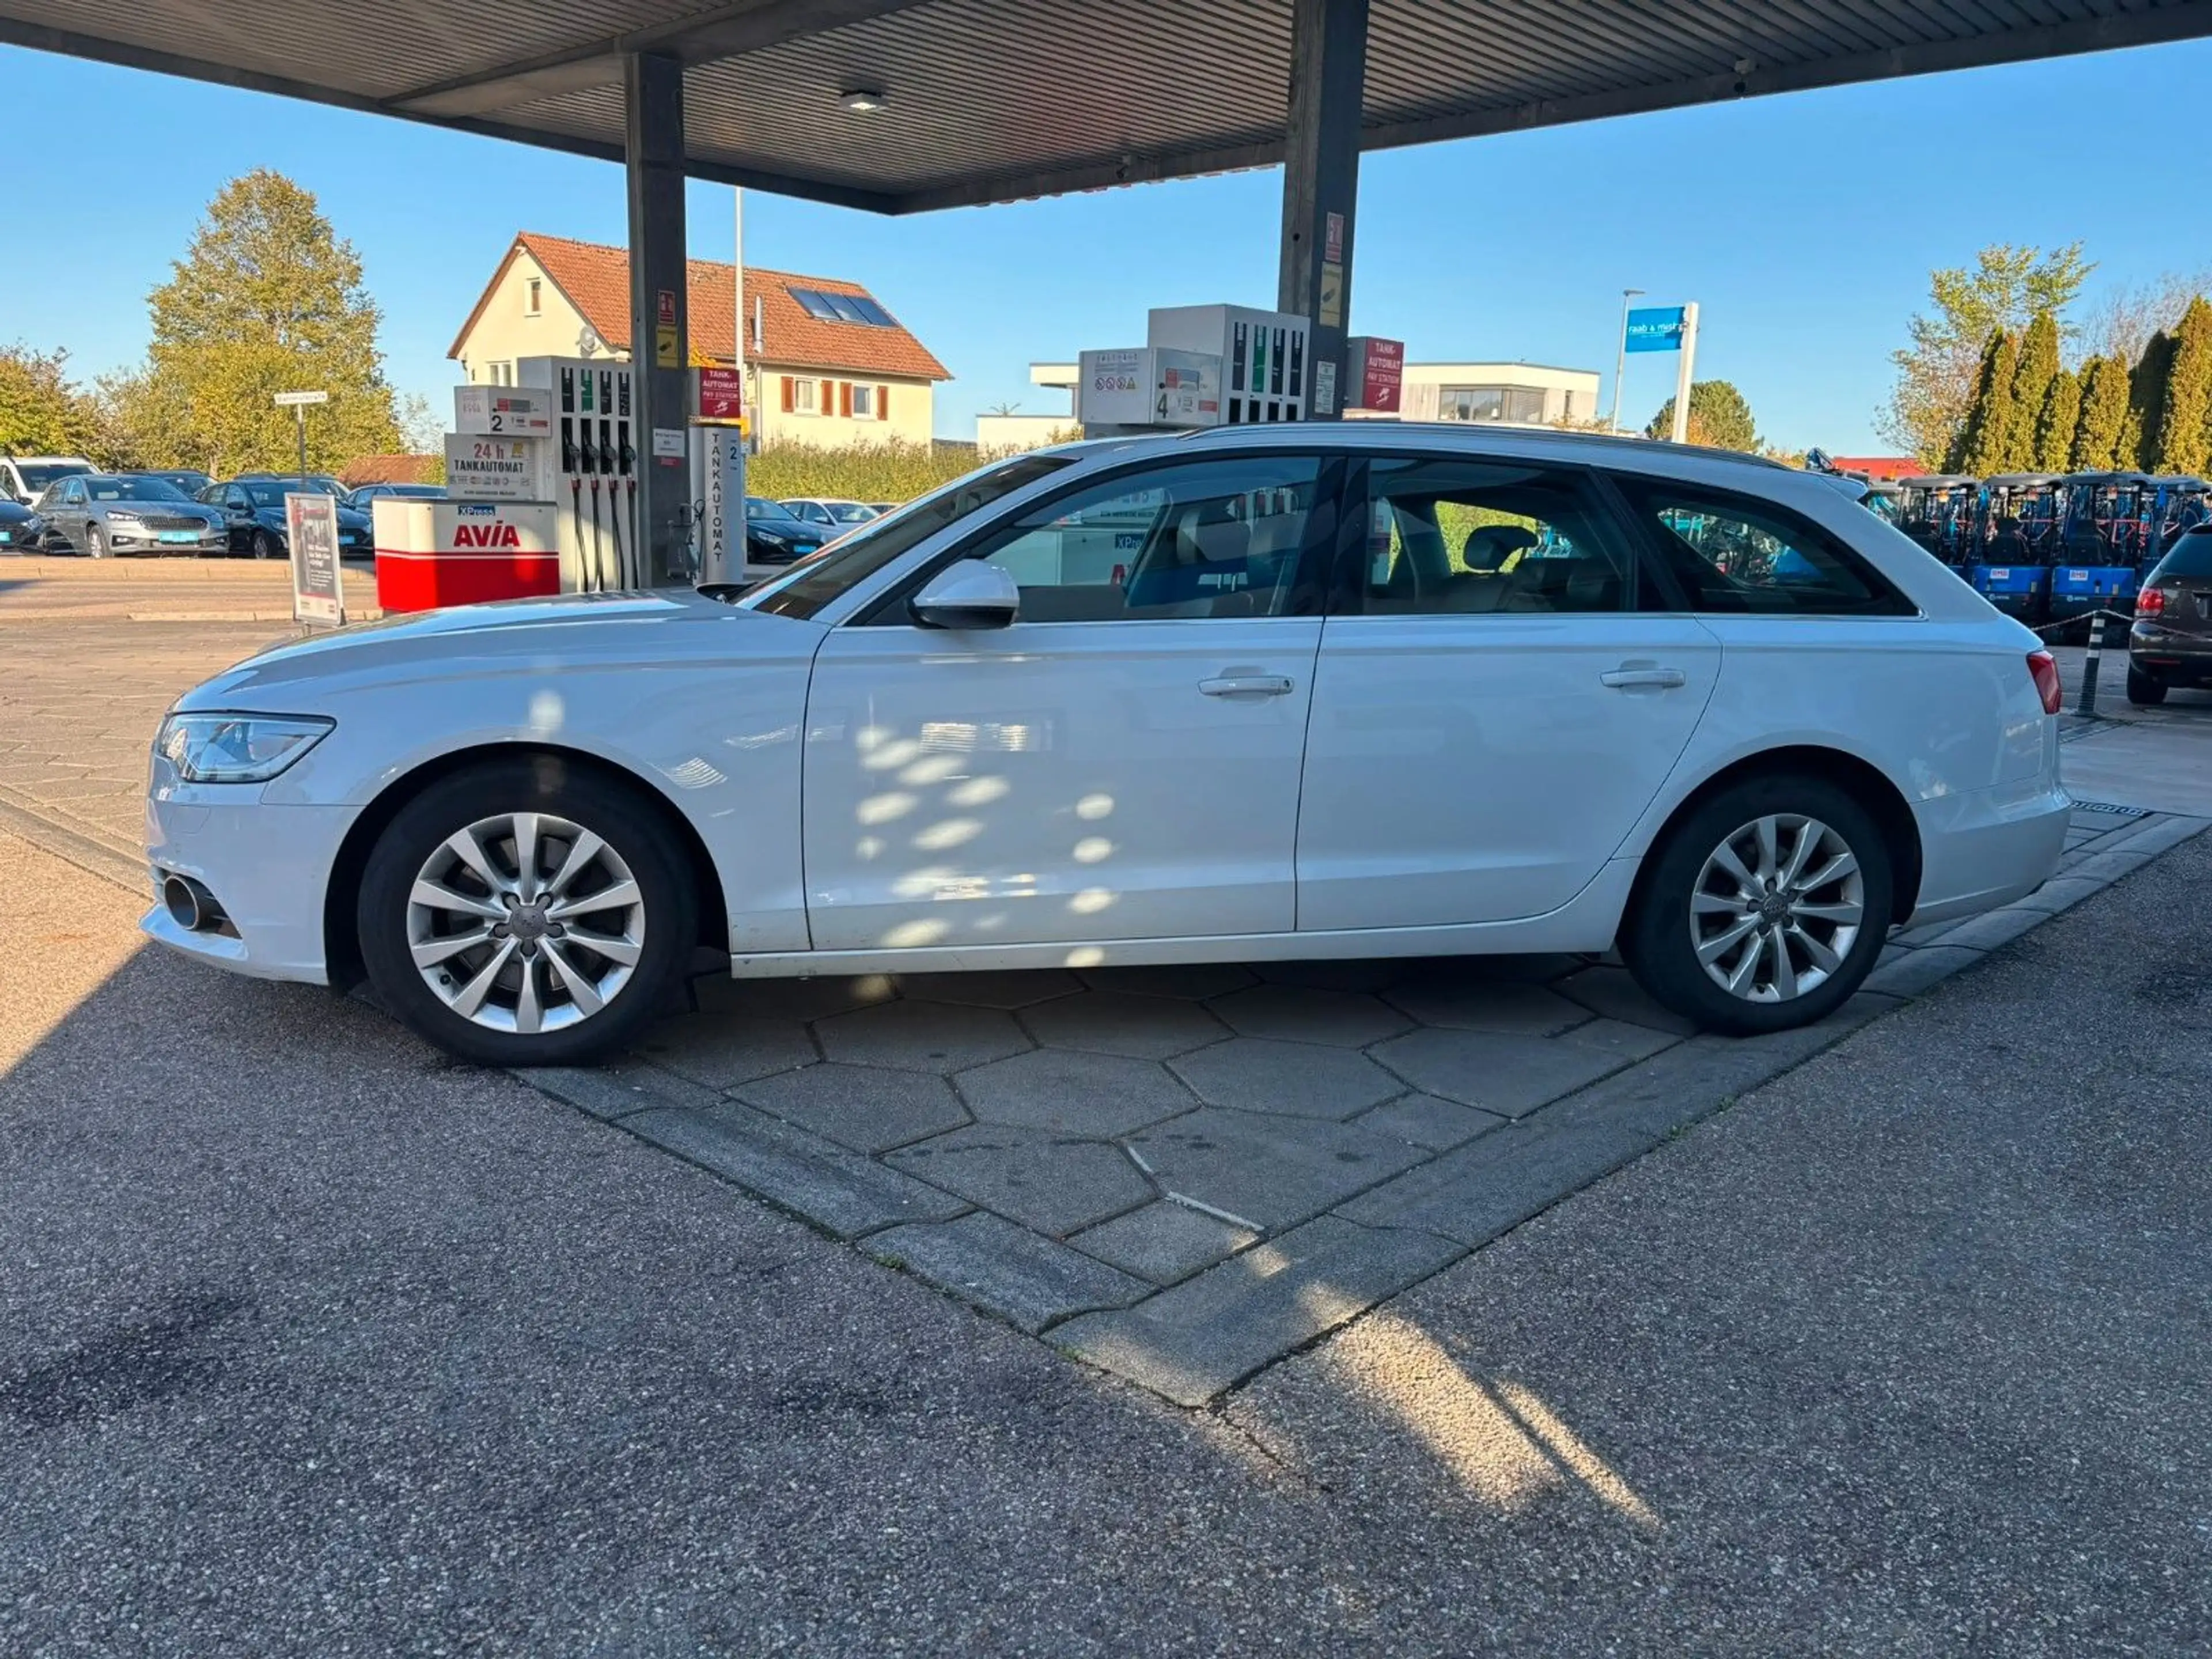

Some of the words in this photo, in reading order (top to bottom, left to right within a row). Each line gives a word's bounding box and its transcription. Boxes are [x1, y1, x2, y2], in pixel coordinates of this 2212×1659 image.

[1368, 356, 1400, 370] AUTOMAT
[703, 380, 738, 389] AUTOMAT
[1157, 393, 1168, 419] 4
[491, 414, 503, 433] 2
[474, 442, 492, 459] 24
[496, 444, 504, 459] h
[730, 446, 737, 460] 2
[454, 460, 524, 473] TANKAUTOMAT
[712, 433, 722, 562] TANKAUTOMAT
[460, 506, 495, 516] XPress
[454, 520, 521, 547] AVIA
[1117, 535, 1144, 550] XPre
